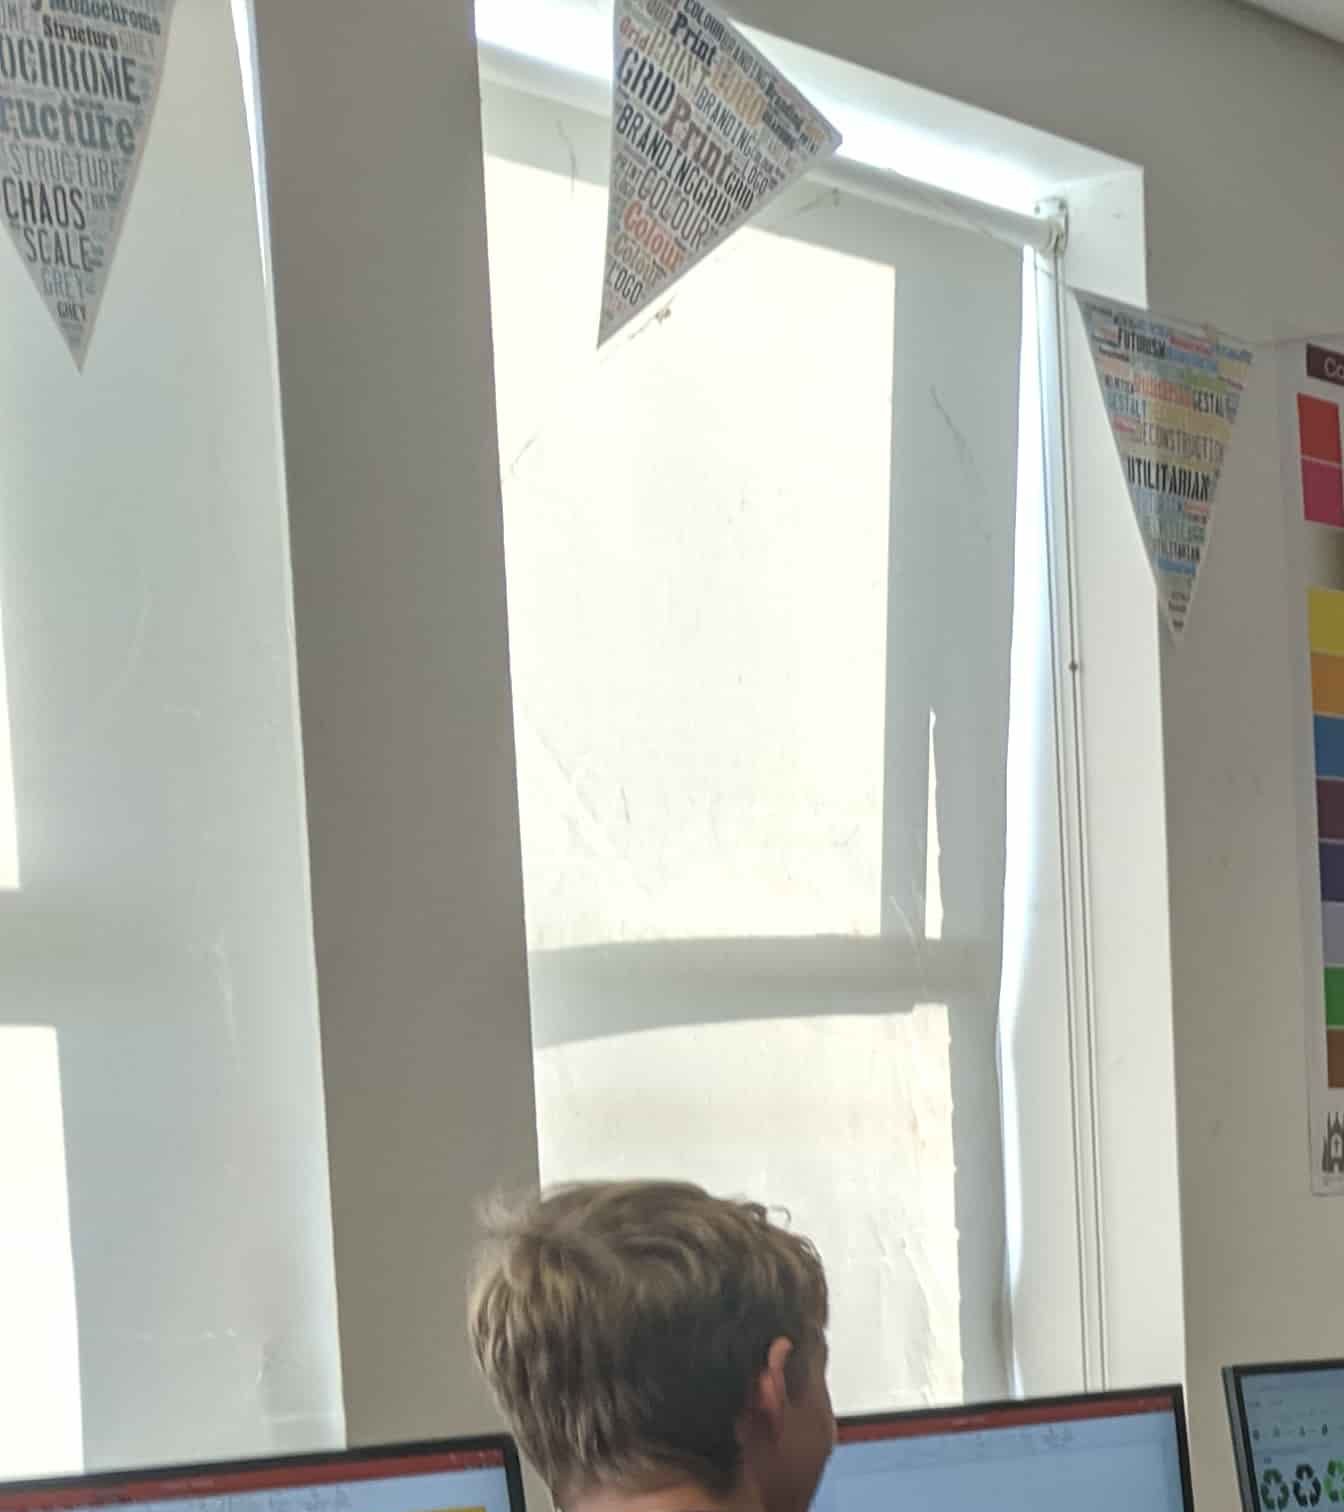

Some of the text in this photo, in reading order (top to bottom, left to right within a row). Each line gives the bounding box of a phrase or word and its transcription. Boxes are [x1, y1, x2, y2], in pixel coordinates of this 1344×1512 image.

[42, 13, 119, 50] Structure
[670, 11, 721, 68] Print
[618, 47, 677, 117] GRID
[616, 103, 702, 196] BRANDING
[661, 94, 737, 188] Print
[2, 176, 86, 231] CHAOS
[637, 167, 710, 249] COLOUR
[691, 173, 732, 226] GRID
[23, 226, 95, 272] SCALE
[624, 199, 688, 273] Colour
[607, 259, 644, 305] LOGO
[1126, 455, 1211, 502] UTILITARIAN
